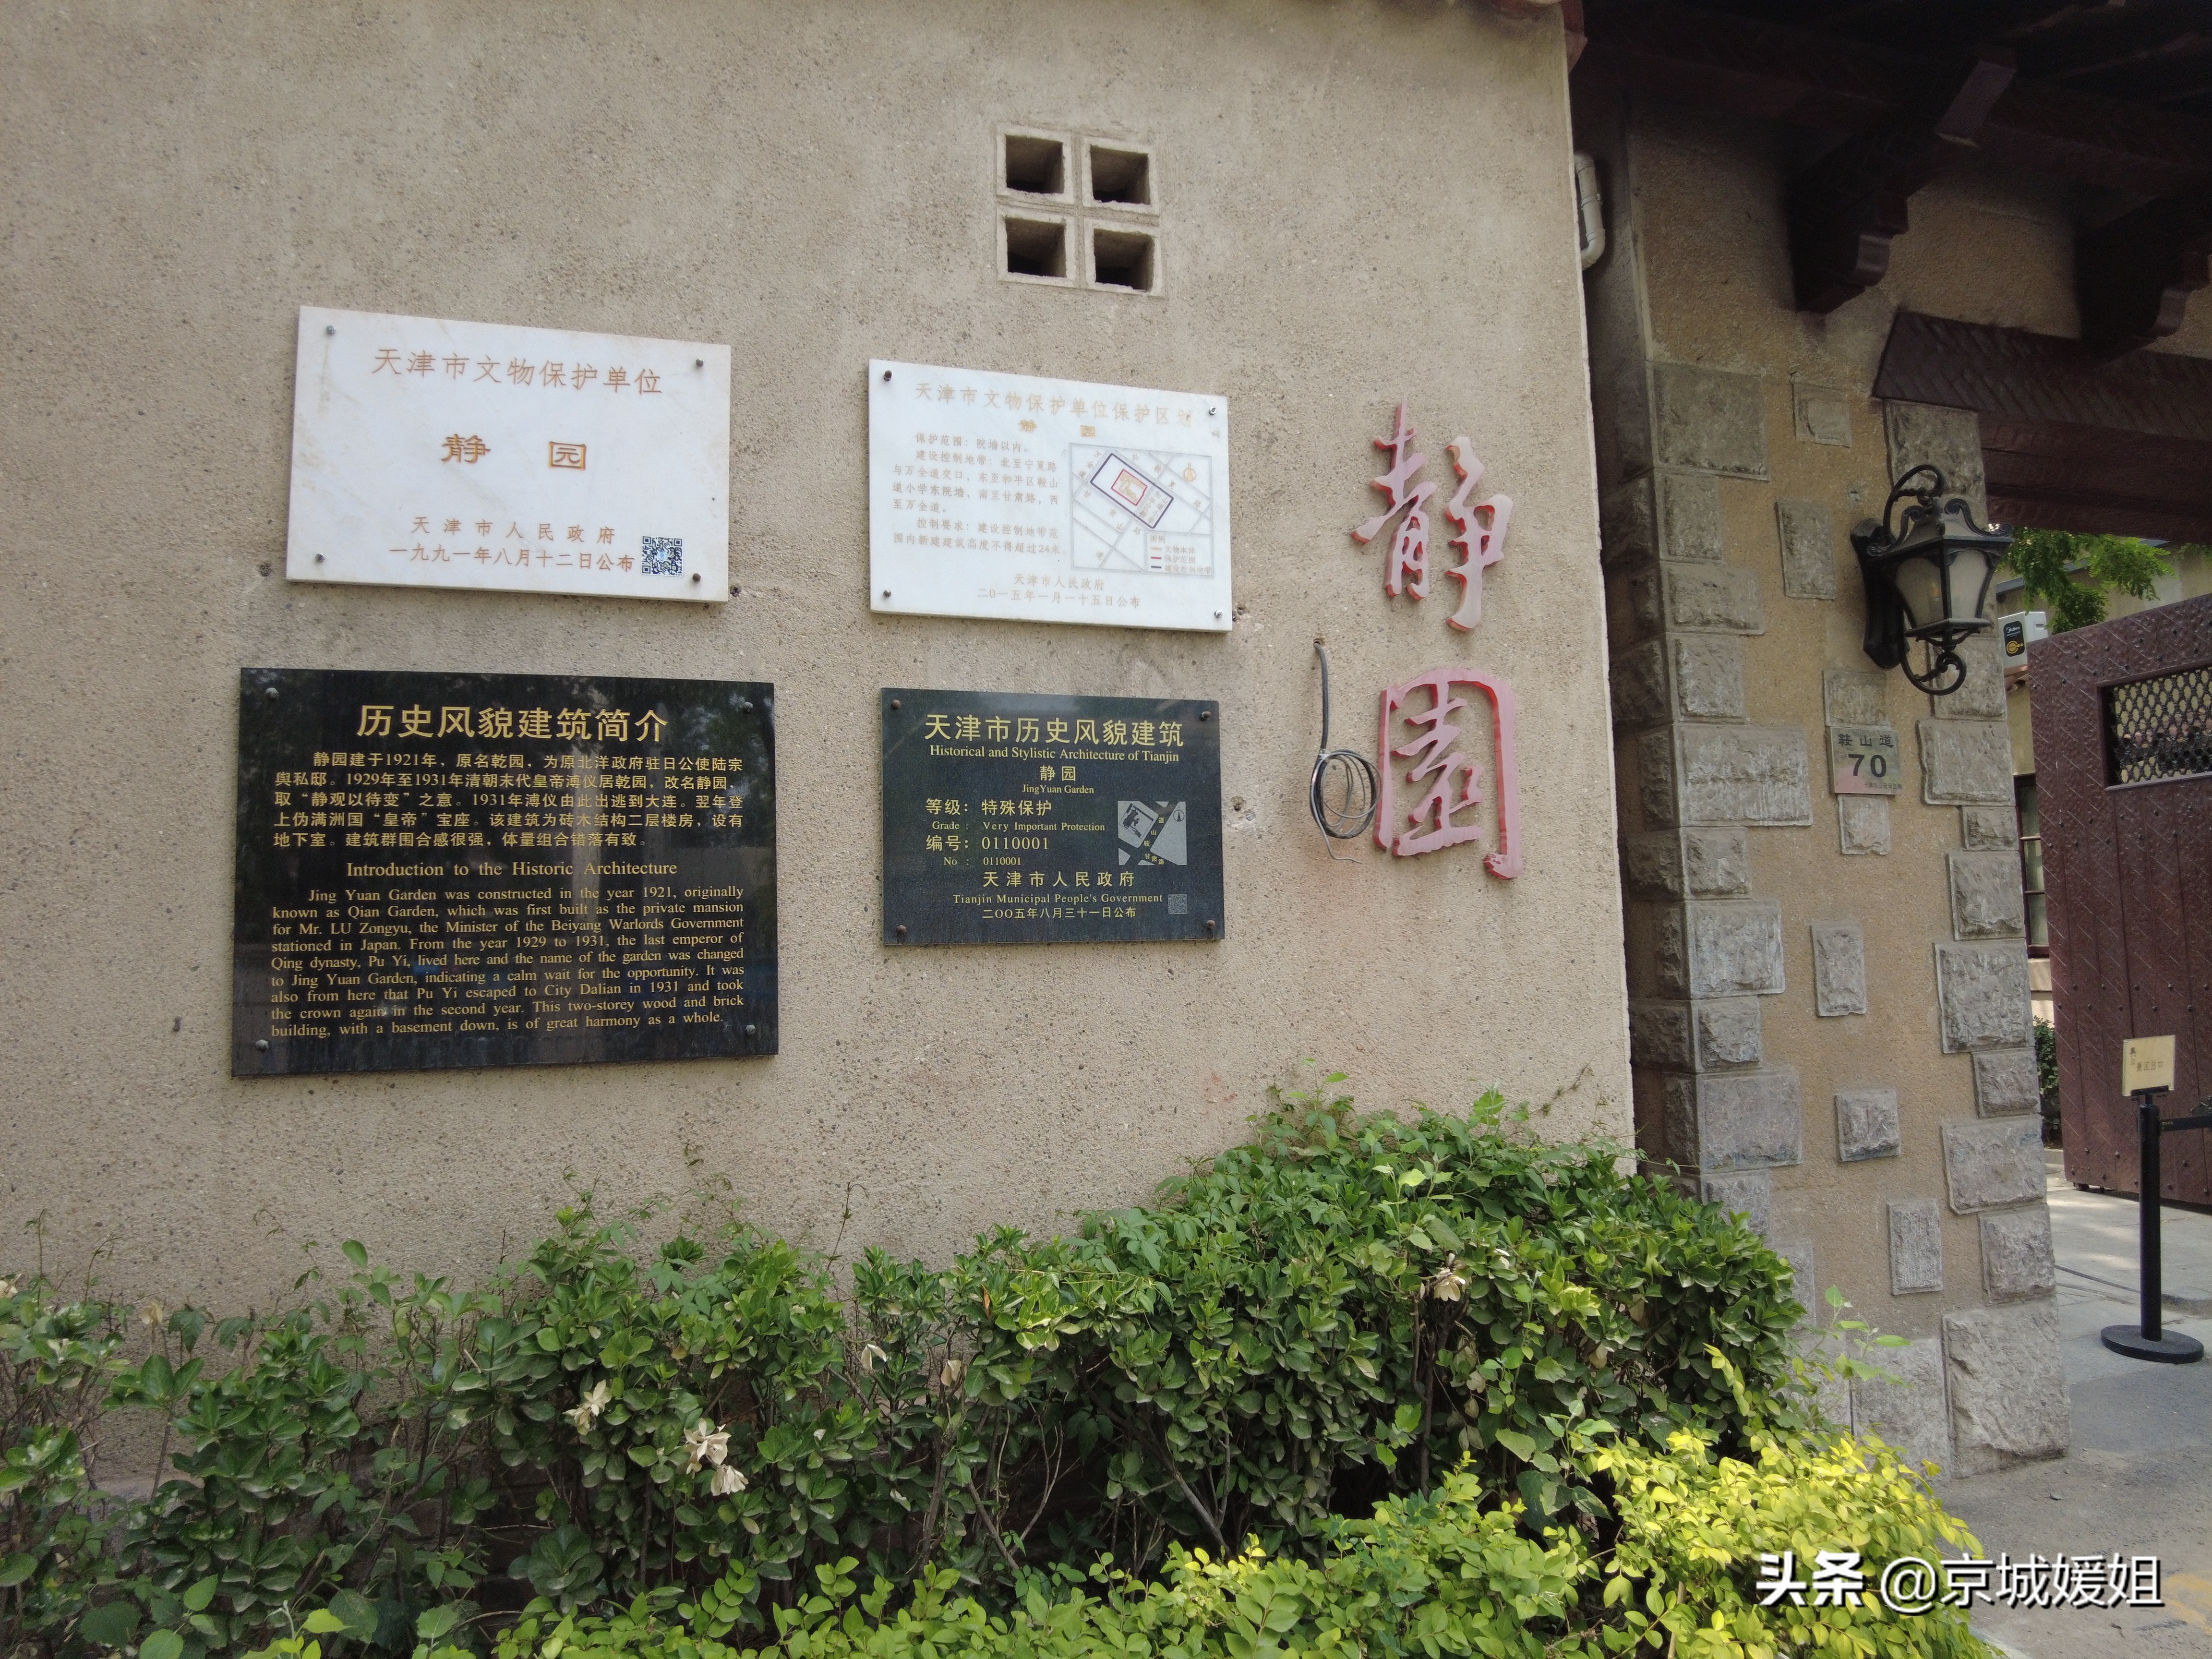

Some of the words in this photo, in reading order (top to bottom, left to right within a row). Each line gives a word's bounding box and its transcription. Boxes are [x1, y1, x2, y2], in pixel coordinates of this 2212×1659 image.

[372, 349, 662, 395] 天津市文物保护单位
[915, 383, 1193, 428] 天津市文物保护单位保护区划
[441, 433, 587, 470] 静园
[411, 517, 614, 544] 天津市人民政府
[389, 543, 635, 572] 一九九一年八月十二日公布
[1014, 574, 1104, 590] 天津市人民政府
[357, 704, 668, 742] 历史风貌建筑简介
[924, 714, 1184, 747] 天津市历史风貌建筑
[1838, 733, 1894, 748] 鞍山道
[930, 745, 985, 757] Historical
[988, 746, 1009, 757] and
[1011, 746, 1056, 761] Stylistic
[1059, 748, 1125, 760] Architecture
[1128, 750, 1140, 761] of
[1142, 750, 1179, 764] Tianjin
[1040, 765, 1076, 781] 静园
[1848, 754, 1887, 778] 70
[1064, 785, 1094, 794] Garden
[981, 799, 1051, 817] 特殊保护
[932, 821, 960, 830] Grade
[983, 821, 1009, 832] Very
[1014, 822, 1057, 832] Important
[1061, 822, 1105, 831] Protection
[982, 837, 1047, 850] 0110001
[347, 862, 444, 876] Introduction
[454, 864, 469, 876] to
[479, 862, 502, 875] the
[512, 862, 573, 875] Historic
[584, 861, 677, 875] Architecture
[944, 857, 957, 865] No
[983, 857, 1021, 866] 0110001
[983, 871, 1134, 888] 天津市人民政府
[308, 890, 337, 904] Jing
[345, 890, 380, 901] Yuan
[389, 889, 436, 900] Garden
[445, 891, 469, 900] was
[478, 888, 552, 900] constructed
[560, 888, 571, 899] in
[580, 888, 599, 898] the
[606, 890, 635, 901] year
[644, 886, 676, 899] 1921,
[685, 886, 744, 900] originally
[953, 894, 992, 905] Tianjin
[997, 894, 1050, 905] Municipal
[1055, 894, 1097, 905] People's
[1101, 893, 1163, 902] Government
[273, 907, 317, 918] known
[326, 909, 340, 917] as
[348, 906, 379, 919] Qian
[387, 905, 439, 918] Garden,
[447, 904, 485, 916] which
[494, 907, 518, 915] was
[527, 904, 552, 915] first
[559, 903, 588, 914] built
[616, 902, 636, 914] the
[643, 902, 685, 916] private
[693, 901, 743, 913] mansion
[273, 923, 292, 935] for
[300, 923, 322, 935] Mr.
[331, 923, 351, 934] LU
[359, 923, 412, 936] Zongyu,
[419, 921, 438, 933] the
[446, 921, 498, 932] Minister
[505, 920, 520, 932] of
[526, 920, 544, 931] the
[552, 919, 601, 933] Beiyang
[609, 918, 664, 930] Warlords
[671, 918, 744, 929] Government
[272, 939, 331, 952] stationed
[340, 940, 352, 951] in
[361, 939, 401, 953] Japan.
[410, 938, 444, 950] From
[453, 938, 472, 949] the
[480, 940, 507, 951] year
[517, 936, 547, 948] 1929
[554, 938, 567, 947] to
[577, 935, 609, 948] 1931,
[617, 934, 636, 945] the
[644, 934, 665, 945] last
[673, 936, 723, 947] emperor
[730, 932, 745, 943] of
[271, 991, 299, 1002] also
[308, 990, 339, 1002] from
[348, 989, 376, 1000] here
[384, 988, 409, 999] that
[417, 988, 433, 999] Pu
[442, 987, 457, 998] Yi
[466, 985, 516, 1000] escaped
[524, 987, 537, 996] to
[545, 985, 572, 998] City
[580, 983, 621, 995] Dalian
[630, 982, 641, 993] in
[651, 981, 678, 993] 1931
[687, 980, 709, 991] and
[717, 979, 744, 990] took
[272, 1008, 292, 1019] the
[300, 1010, 341, 1019] crown
[349, 1007, 385, 1020] again
[394, 1005, 405, 1016] in
[414, 1004, 433, 1015] the
[441, 1002, 485, 1015] second
[493, 1005, 524, 1016] year.
[532, 1001, 560, 1012] This
[568, 1001, 634, 1012] two-storey
[642, 997, 676, 1009] wood
[684, 996, 706, 1007] and
[713, 994, 744, 1006] brick
[272, 1024, 331, 1038] building,
[339, 1022, 368, 1034] with
[376, 1025, 384, 1034] a
[392, 1022, 452, 1033] basement
[460, 1019, 499, 1031] down,
[508, 1018, 518, 1029] is
[526, 1017, 541, 1029] of
[547, 1018, 578, 1031] great
[586, 1016, 641, 1028] harmony
[648, 1016, 661, 1024] as
[683, 1011, 723, 1023] whole.
